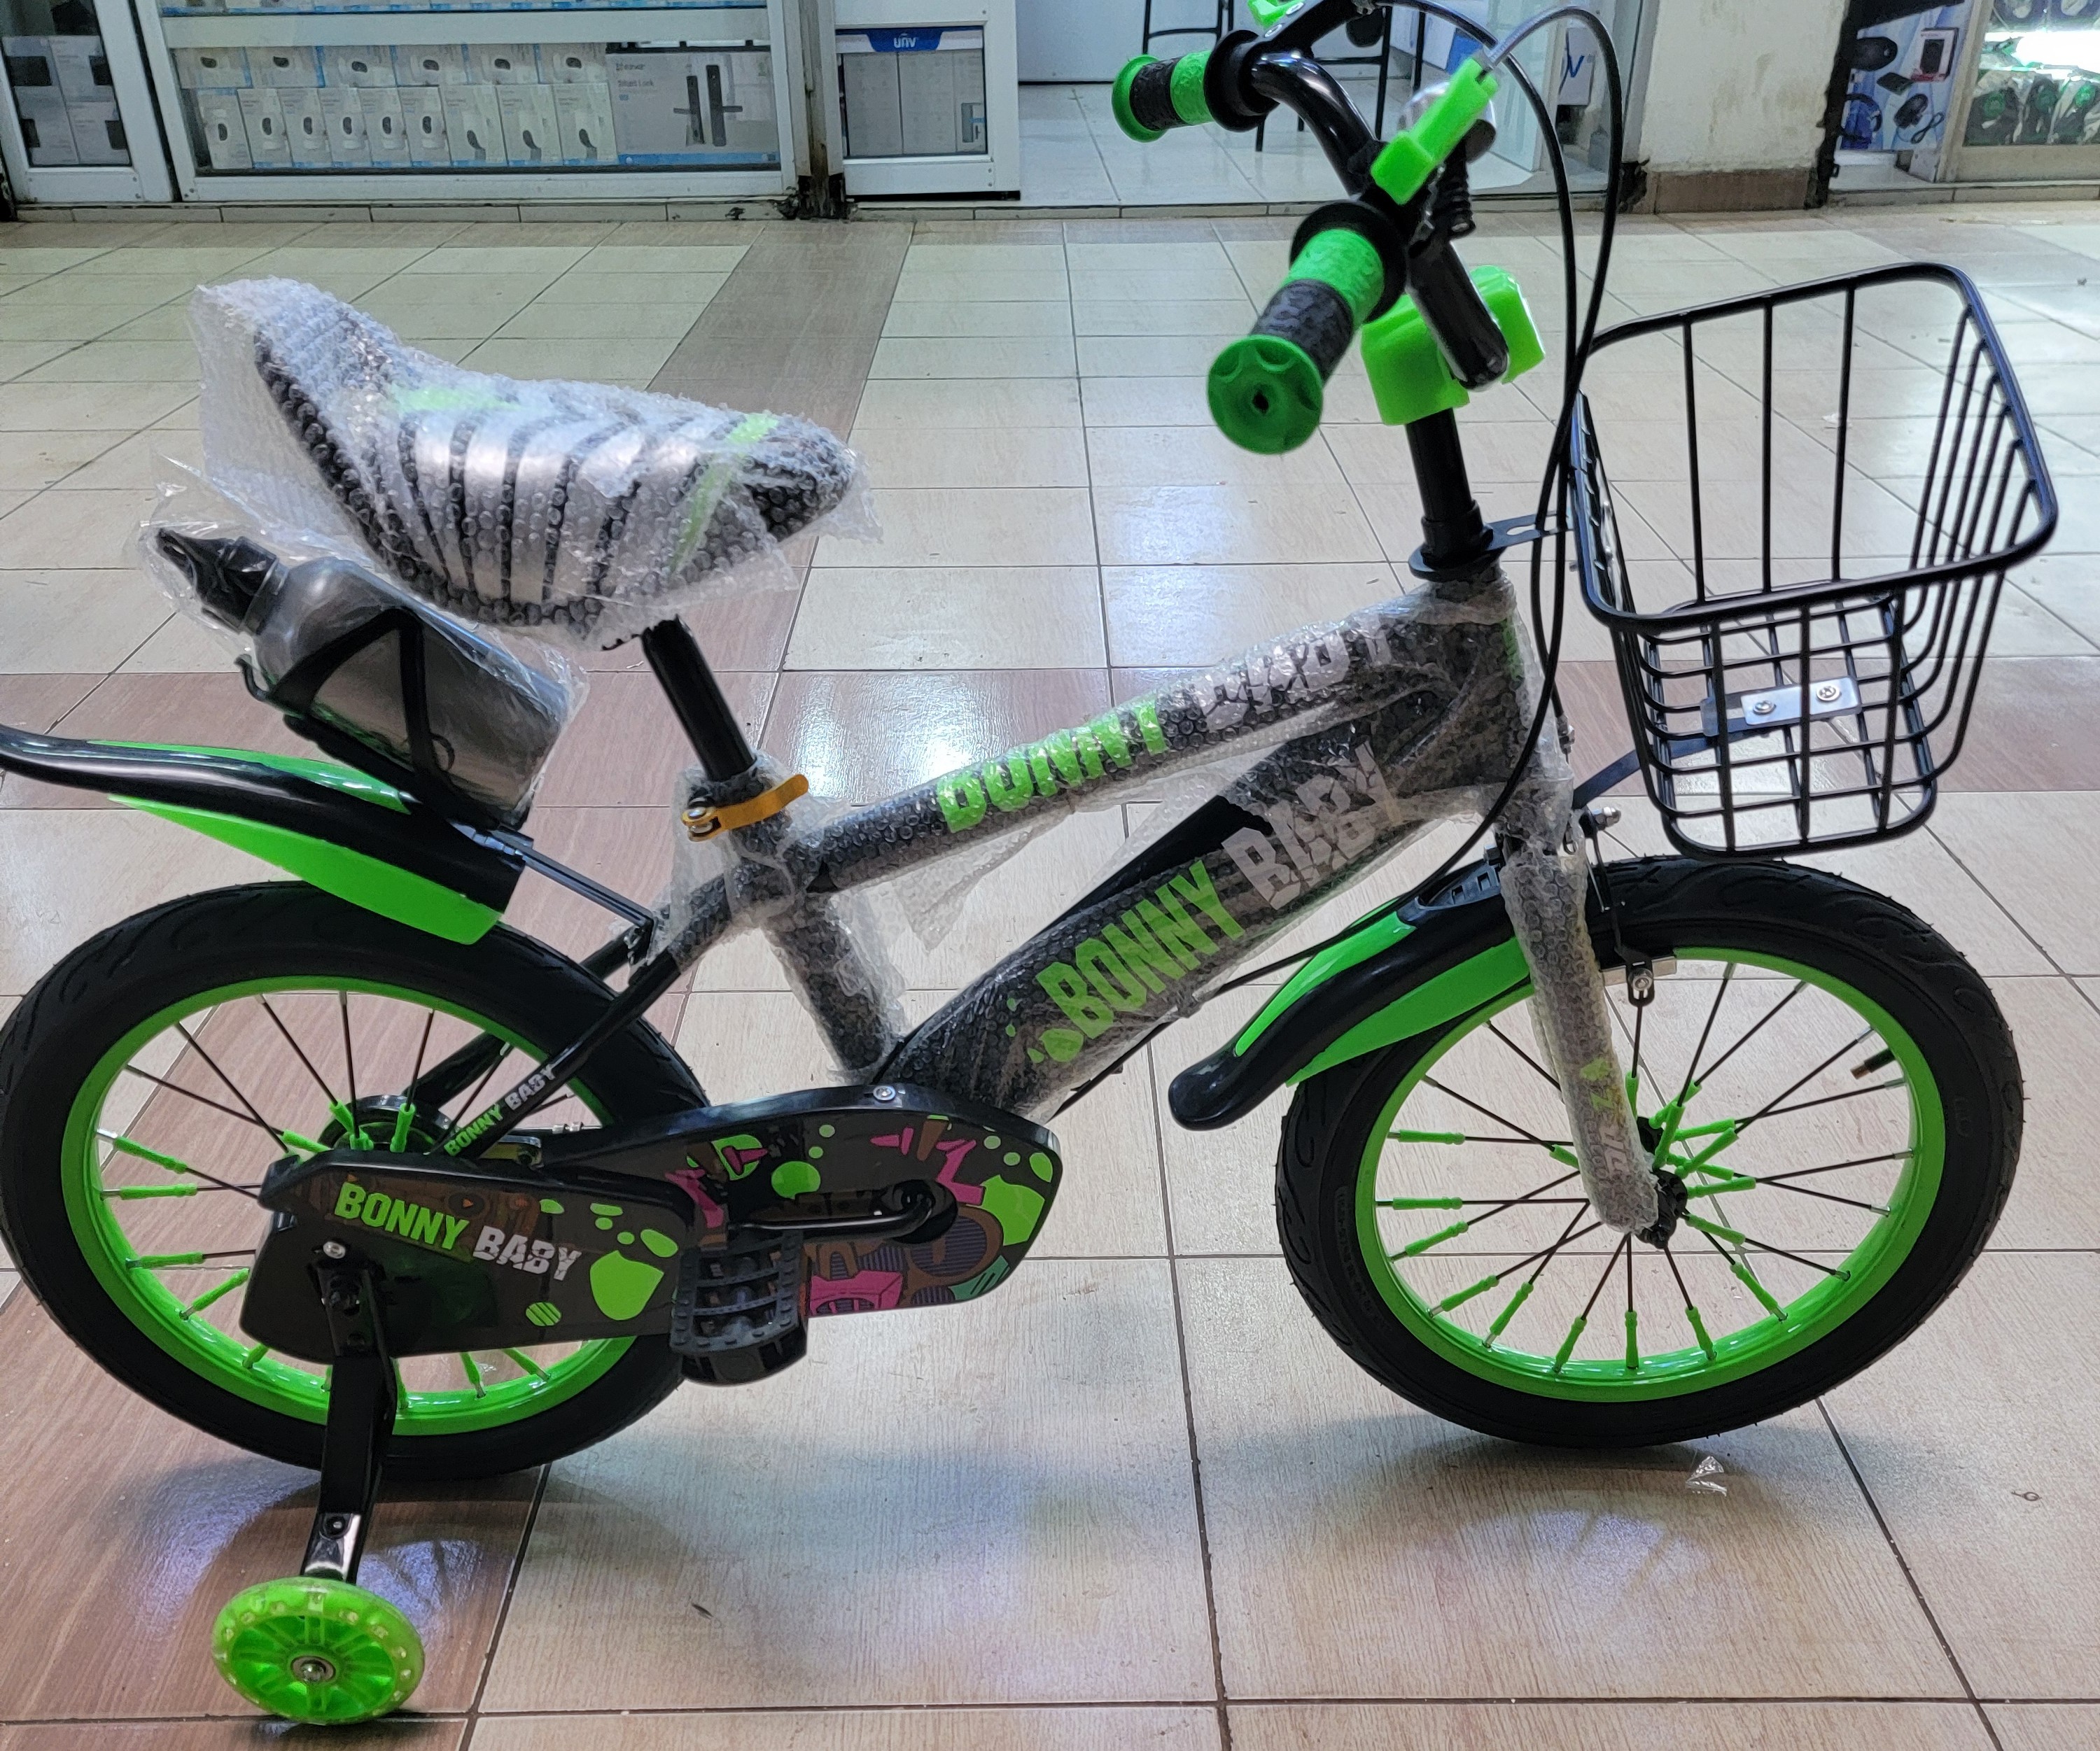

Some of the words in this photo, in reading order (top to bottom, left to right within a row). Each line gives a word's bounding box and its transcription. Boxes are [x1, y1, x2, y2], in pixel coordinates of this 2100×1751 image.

[1036, 859, 1245, 1039] BONNY
[1221, 739, 1402, 910] BABY
[444, 1103, 503, 1156] BONNY
[504, 1063, 556, 1111] BABY
[334, 1181, 470, 1251] BONNY
[472, 1225, 582, 1281] BABY
